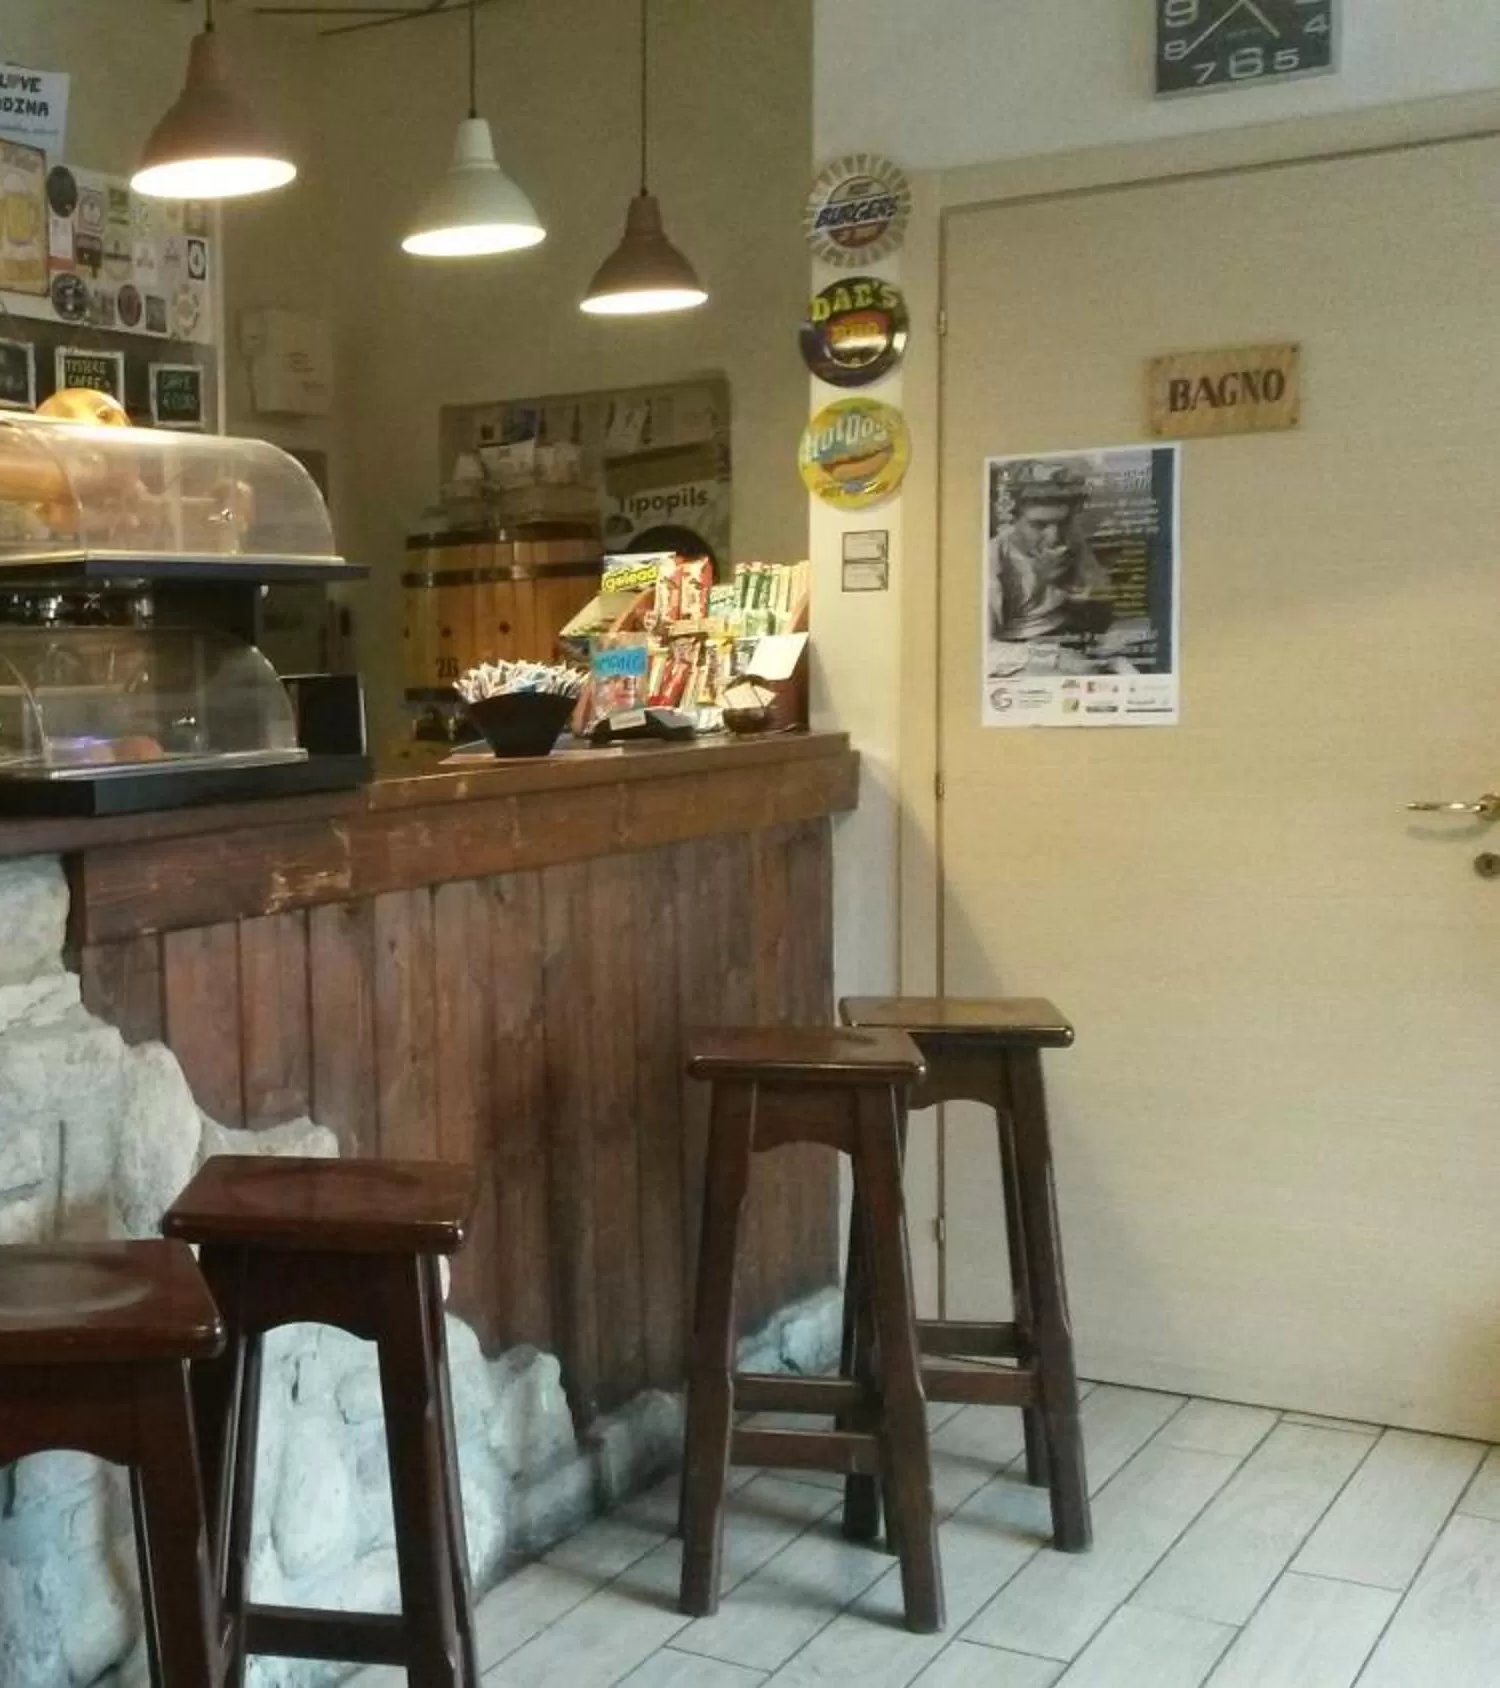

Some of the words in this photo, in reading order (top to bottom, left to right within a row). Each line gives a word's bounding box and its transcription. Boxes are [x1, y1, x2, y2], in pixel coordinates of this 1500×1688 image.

[1192, 61, 1217, 85] 7
[1229, 46, 1264, 80] 6
[1273, 48, 1300, 72] 5
[815, 195, 899, 229] BURGERS
[1169, 368, 1285, 413] BAGNO
